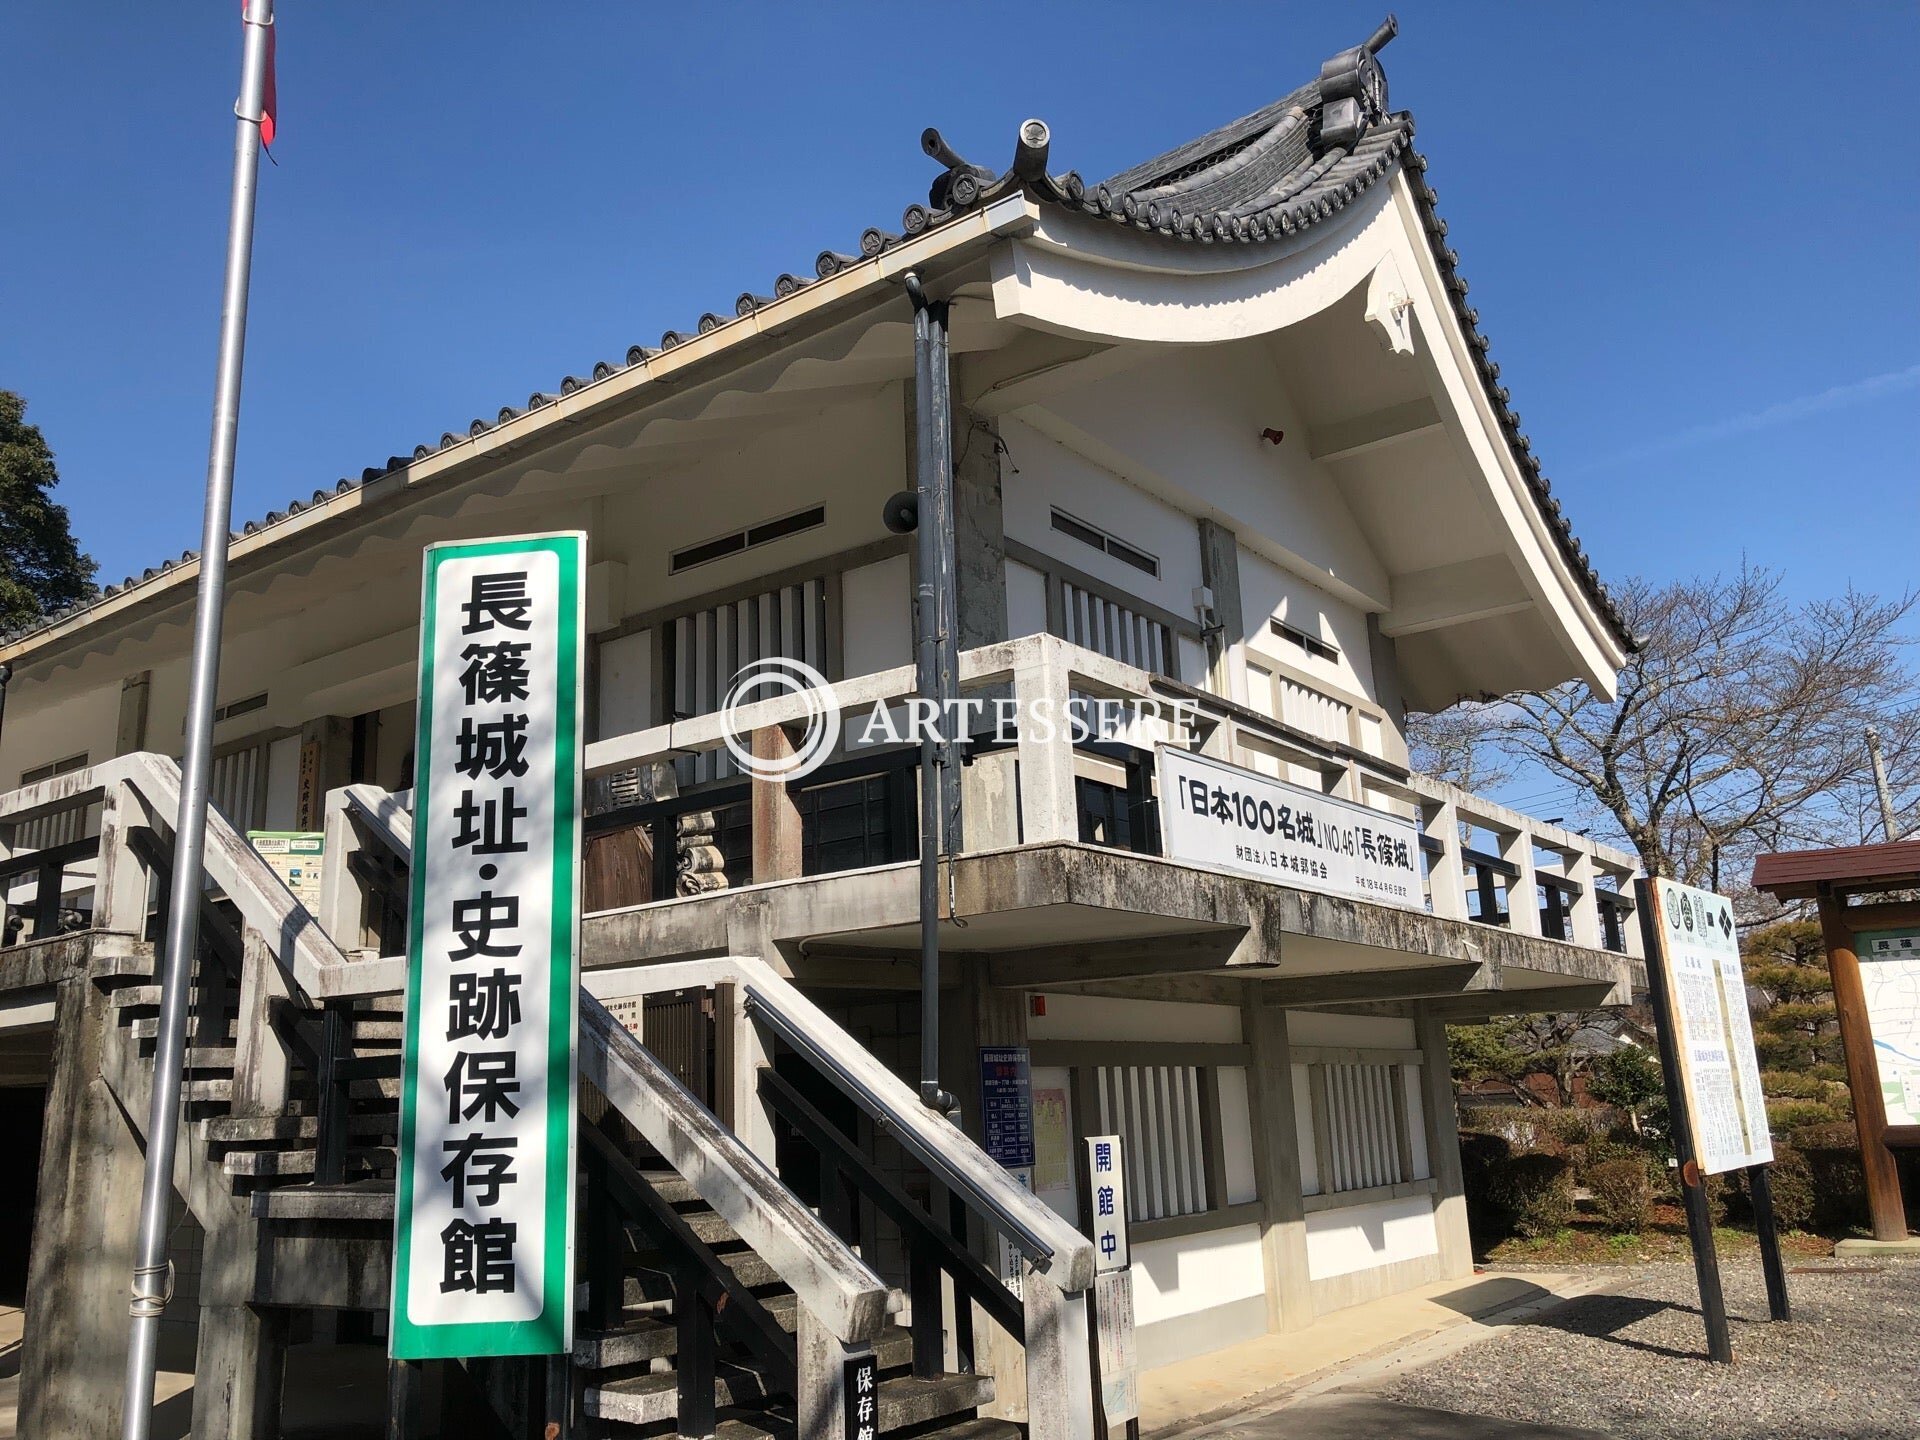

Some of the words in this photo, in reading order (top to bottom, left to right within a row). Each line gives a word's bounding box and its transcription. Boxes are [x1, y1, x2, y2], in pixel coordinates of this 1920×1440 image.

[1235, 845, 1328, 880] 財団法人日本城郭協会
[439, 570, 532, 1295] 長篠城址・史跡保存館
[1095, 1143, 1117, 1261] 開館中
